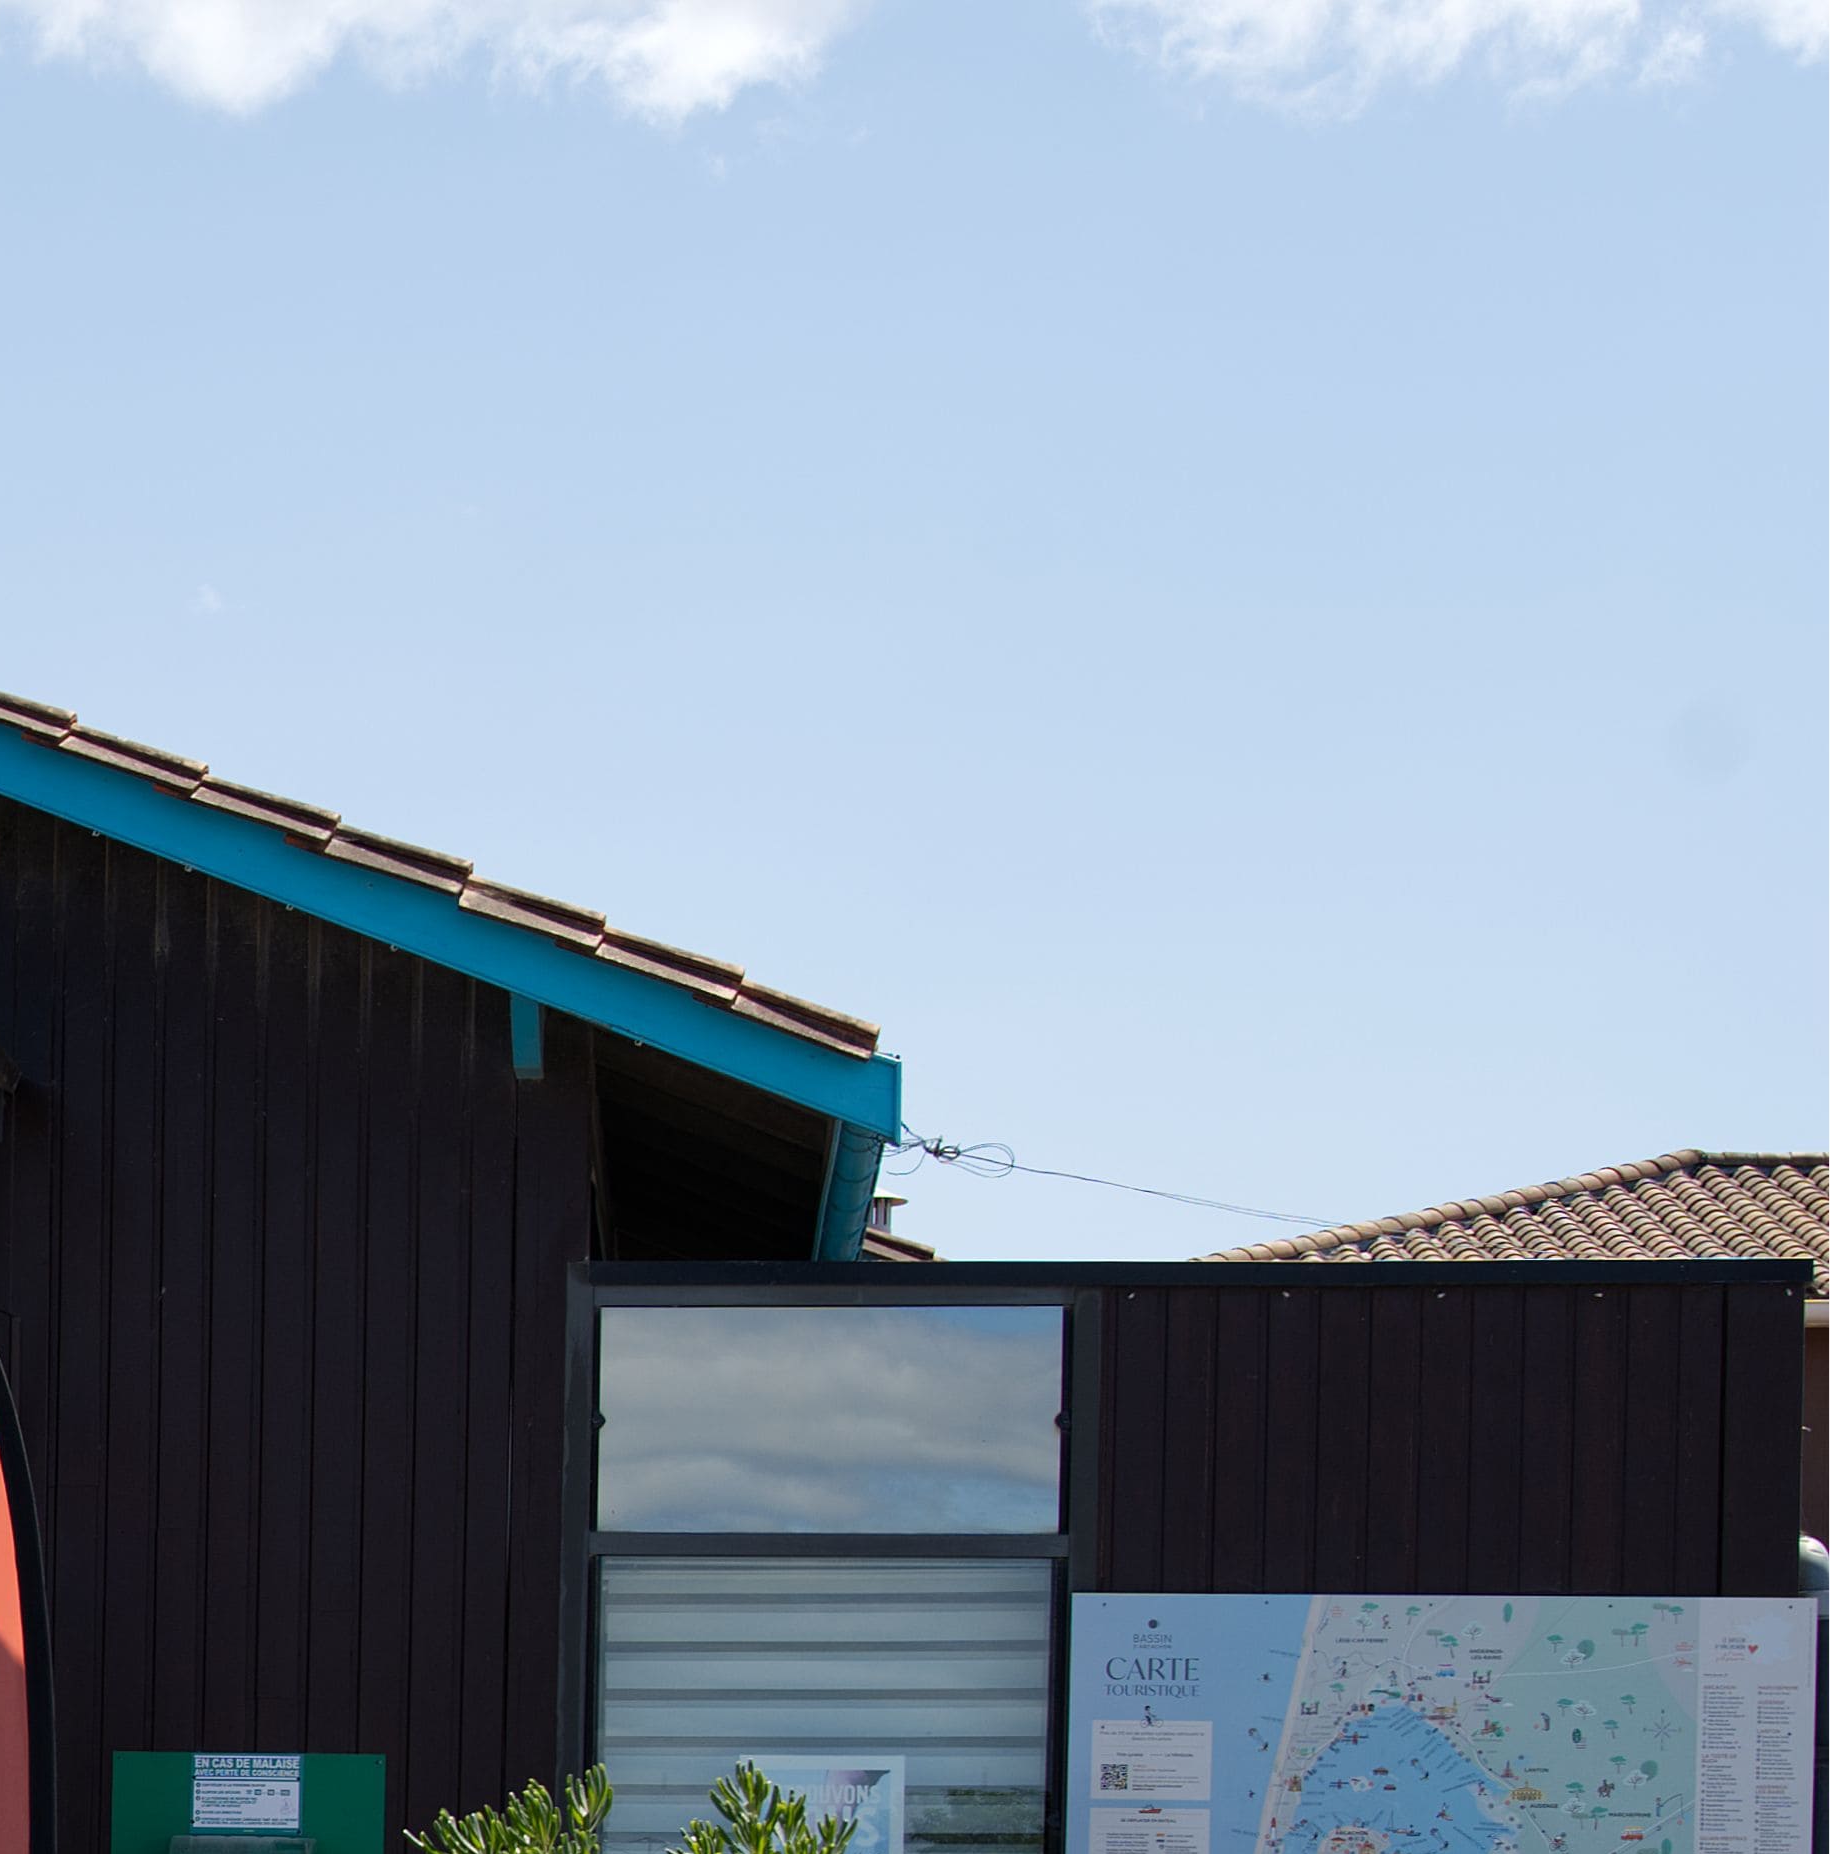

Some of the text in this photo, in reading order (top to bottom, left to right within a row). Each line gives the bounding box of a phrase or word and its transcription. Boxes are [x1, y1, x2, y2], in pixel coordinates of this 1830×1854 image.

[1105, 1656, 1200, 1681] CARTE
[1104, 1683, 1201, 1699] TOURISTIQUE
[211, 1758, 234, 1769] CAS
[235, 1758, 251, 1769] DE
[252, 1758, 301, 1770] MALAISE
